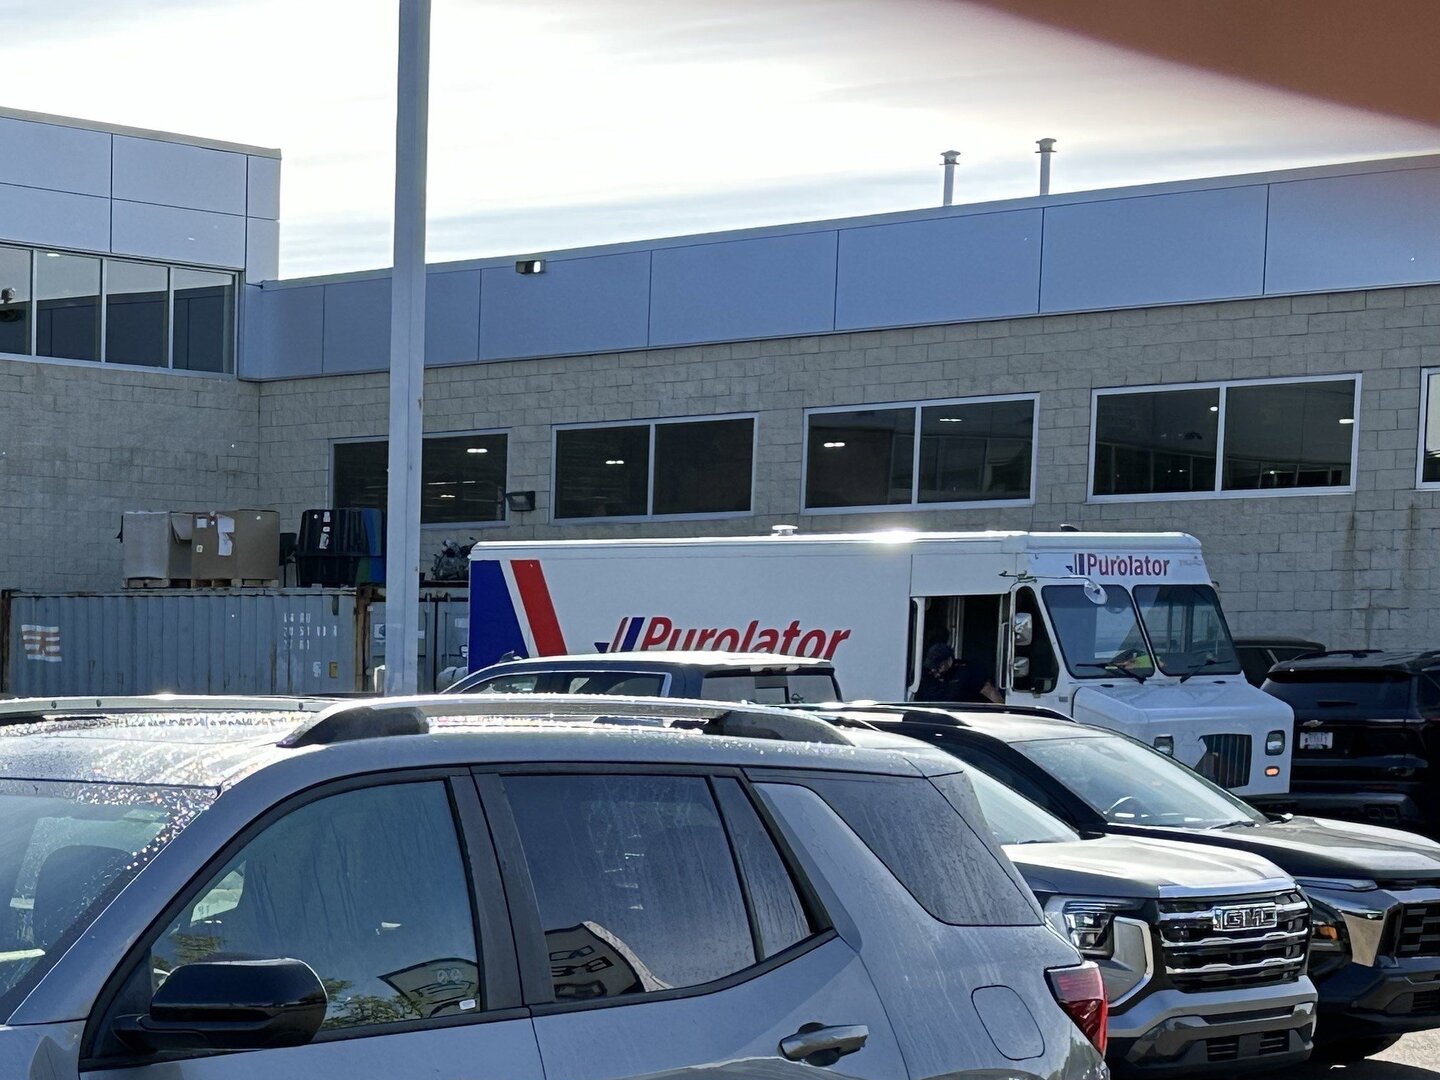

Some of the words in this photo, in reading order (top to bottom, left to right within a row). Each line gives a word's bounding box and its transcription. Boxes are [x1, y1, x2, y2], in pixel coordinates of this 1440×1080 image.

[1086, 553, 1170, 576] Purolator
[640, 616, 851, 661] Purolator
[1224, 906, 1277, 927] GMC
